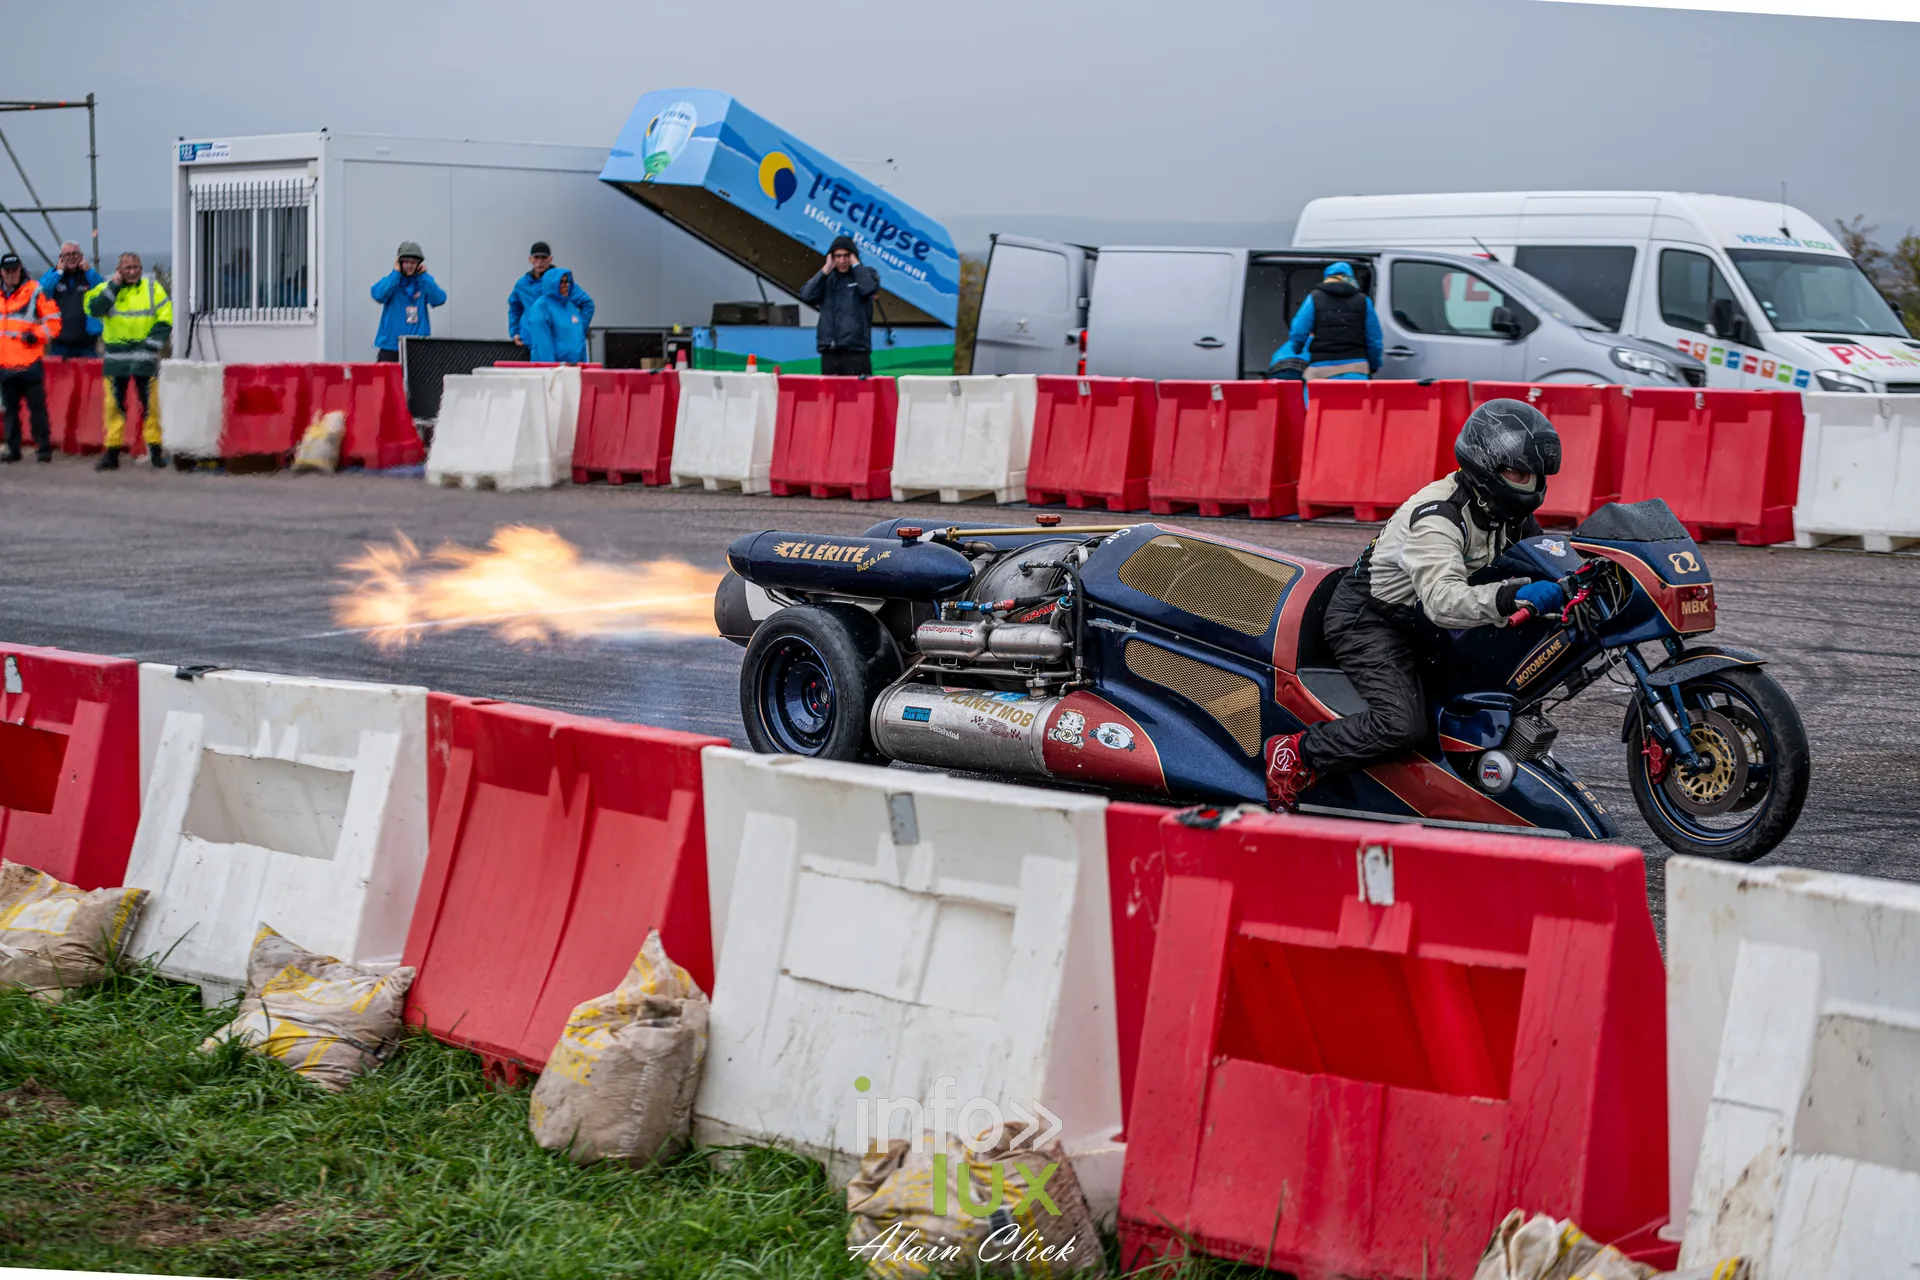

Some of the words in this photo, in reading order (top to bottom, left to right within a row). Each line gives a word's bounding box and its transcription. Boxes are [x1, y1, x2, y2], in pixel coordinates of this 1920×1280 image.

[803, 203, 842, 233] Hôtel
[852, 231, 928, 281] Restaurant
[807, 172, 931, 261] l'Eclipse
[1681, 599, 1709, 615] MBK
[1515, 639, 1563, 686] MOTOBECANE
